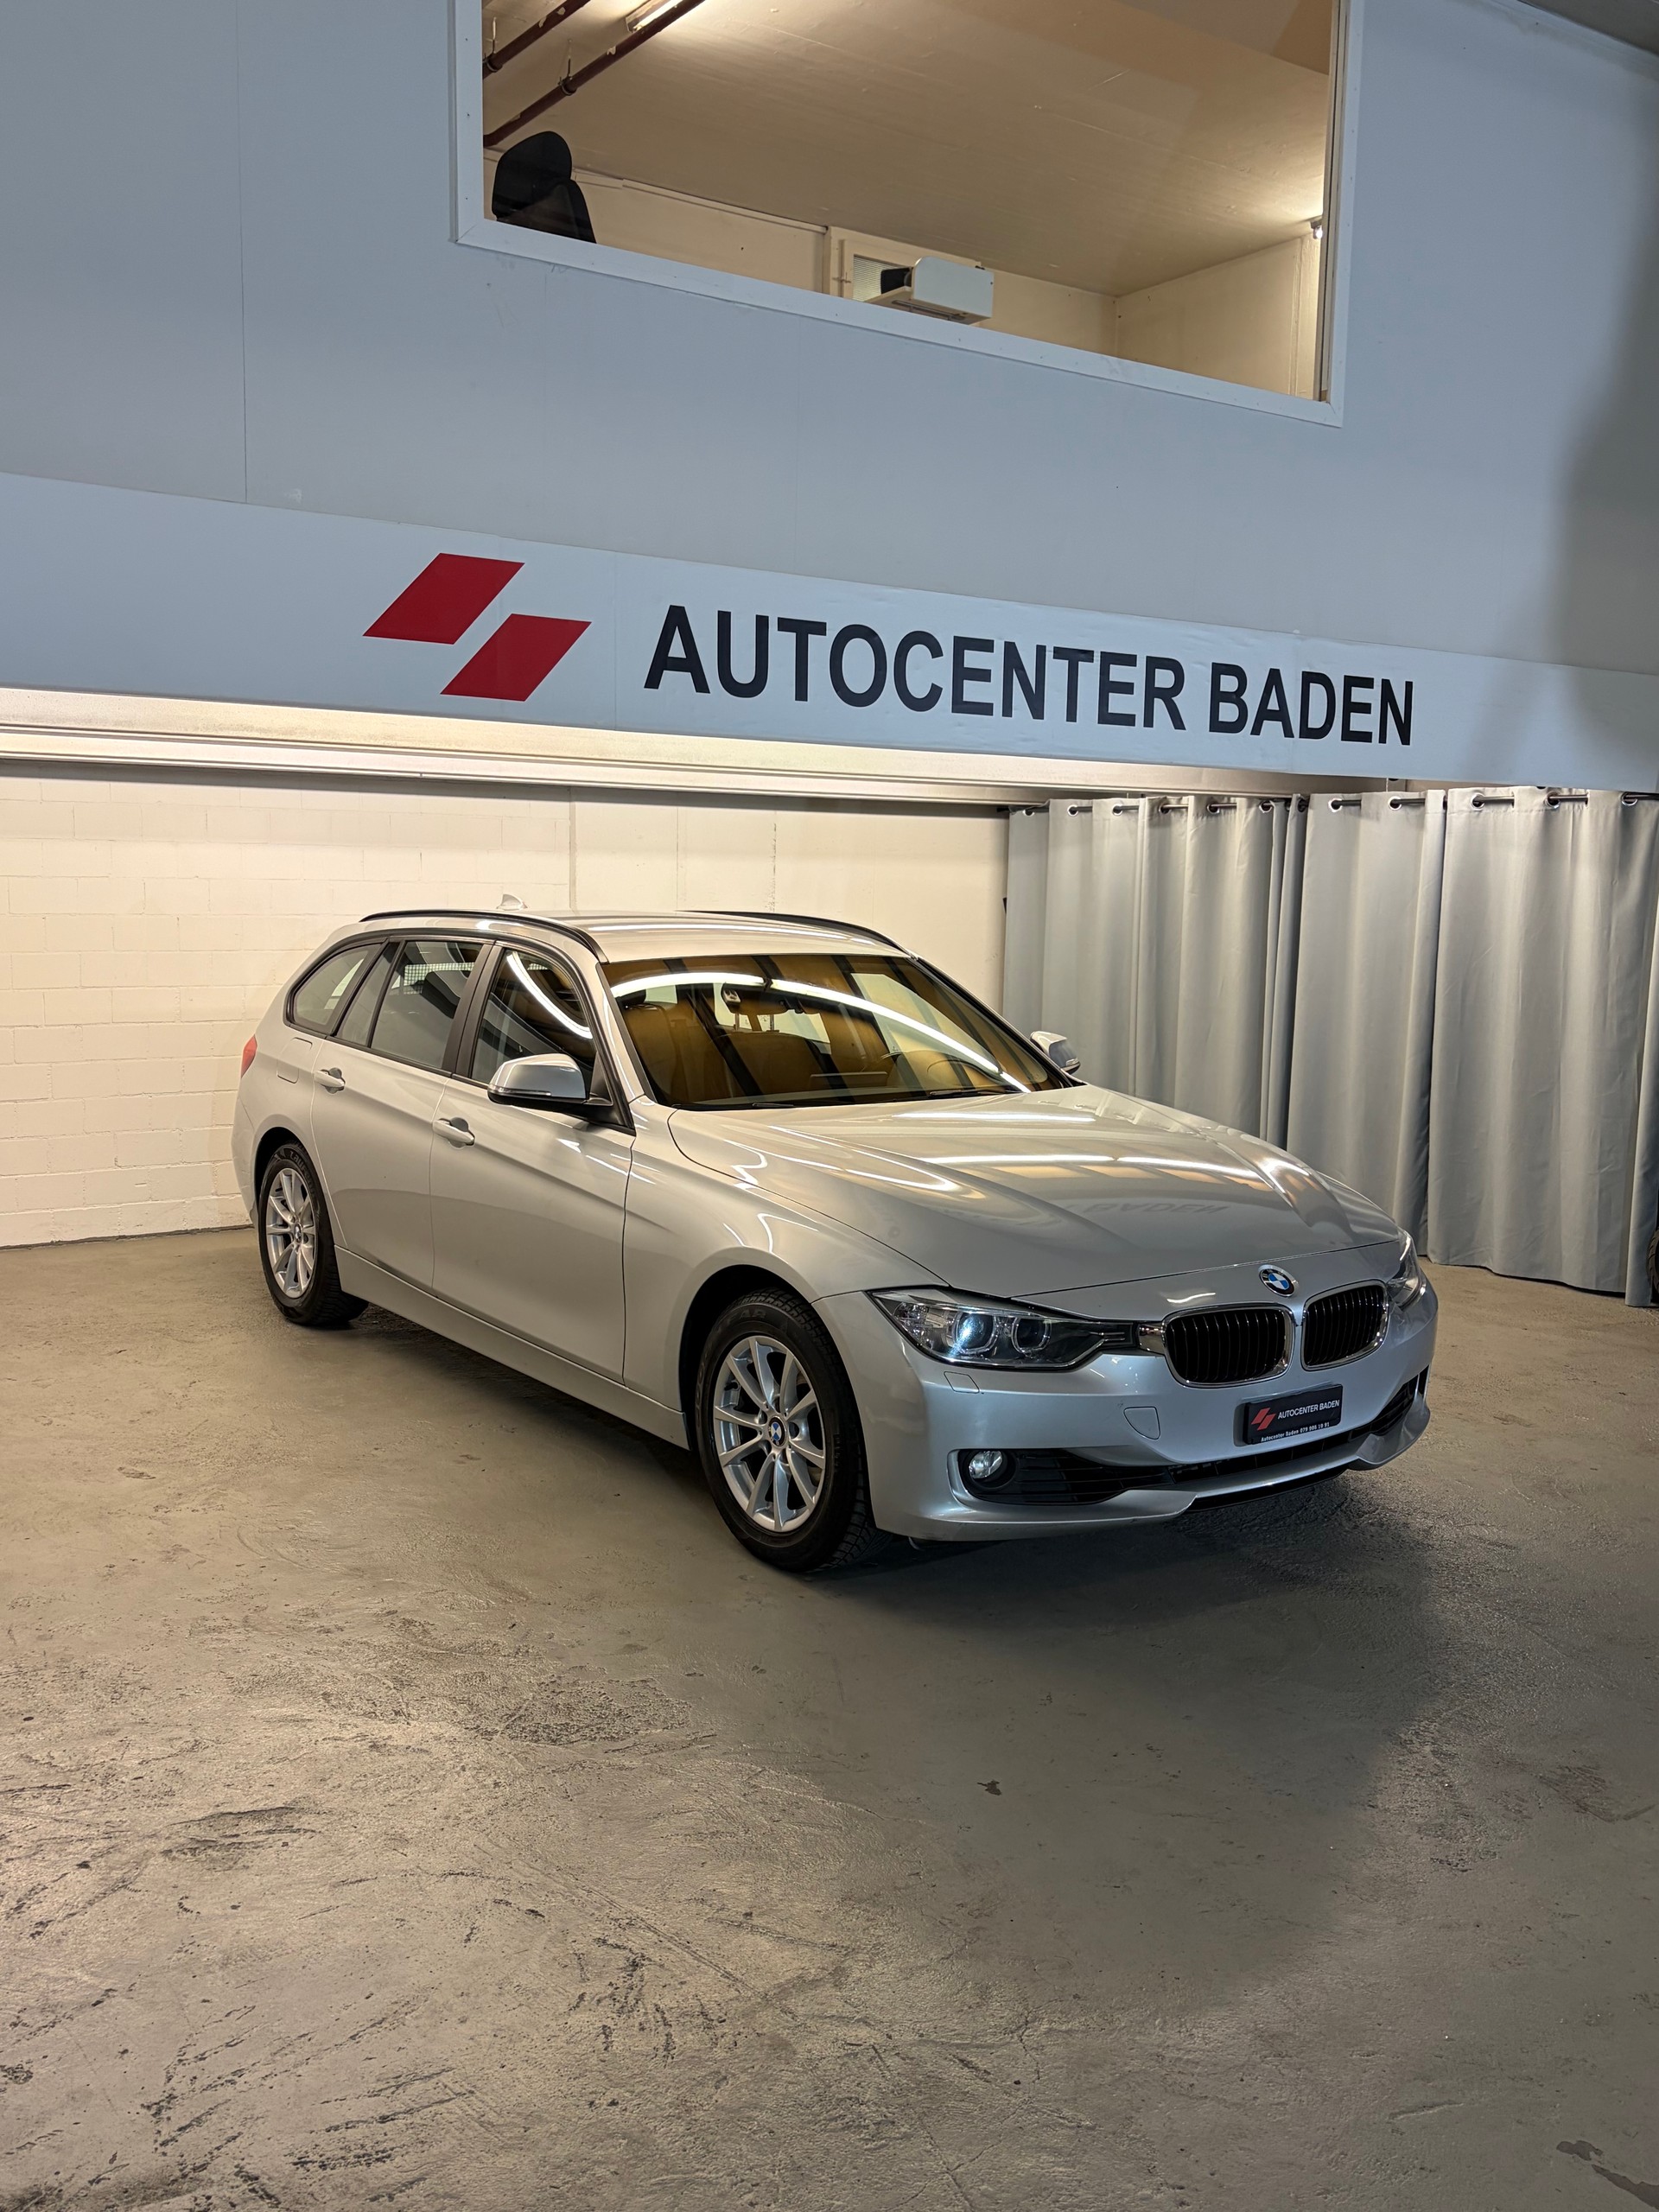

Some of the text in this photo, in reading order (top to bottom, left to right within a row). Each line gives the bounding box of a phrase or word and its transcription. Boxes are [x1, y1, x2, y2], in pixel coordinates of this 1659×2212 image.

[645, 605, 1414, 746] AUTOCENTER BADEN
[1278, 1400, 1339, 1419] AUTOCENTER BADEN
